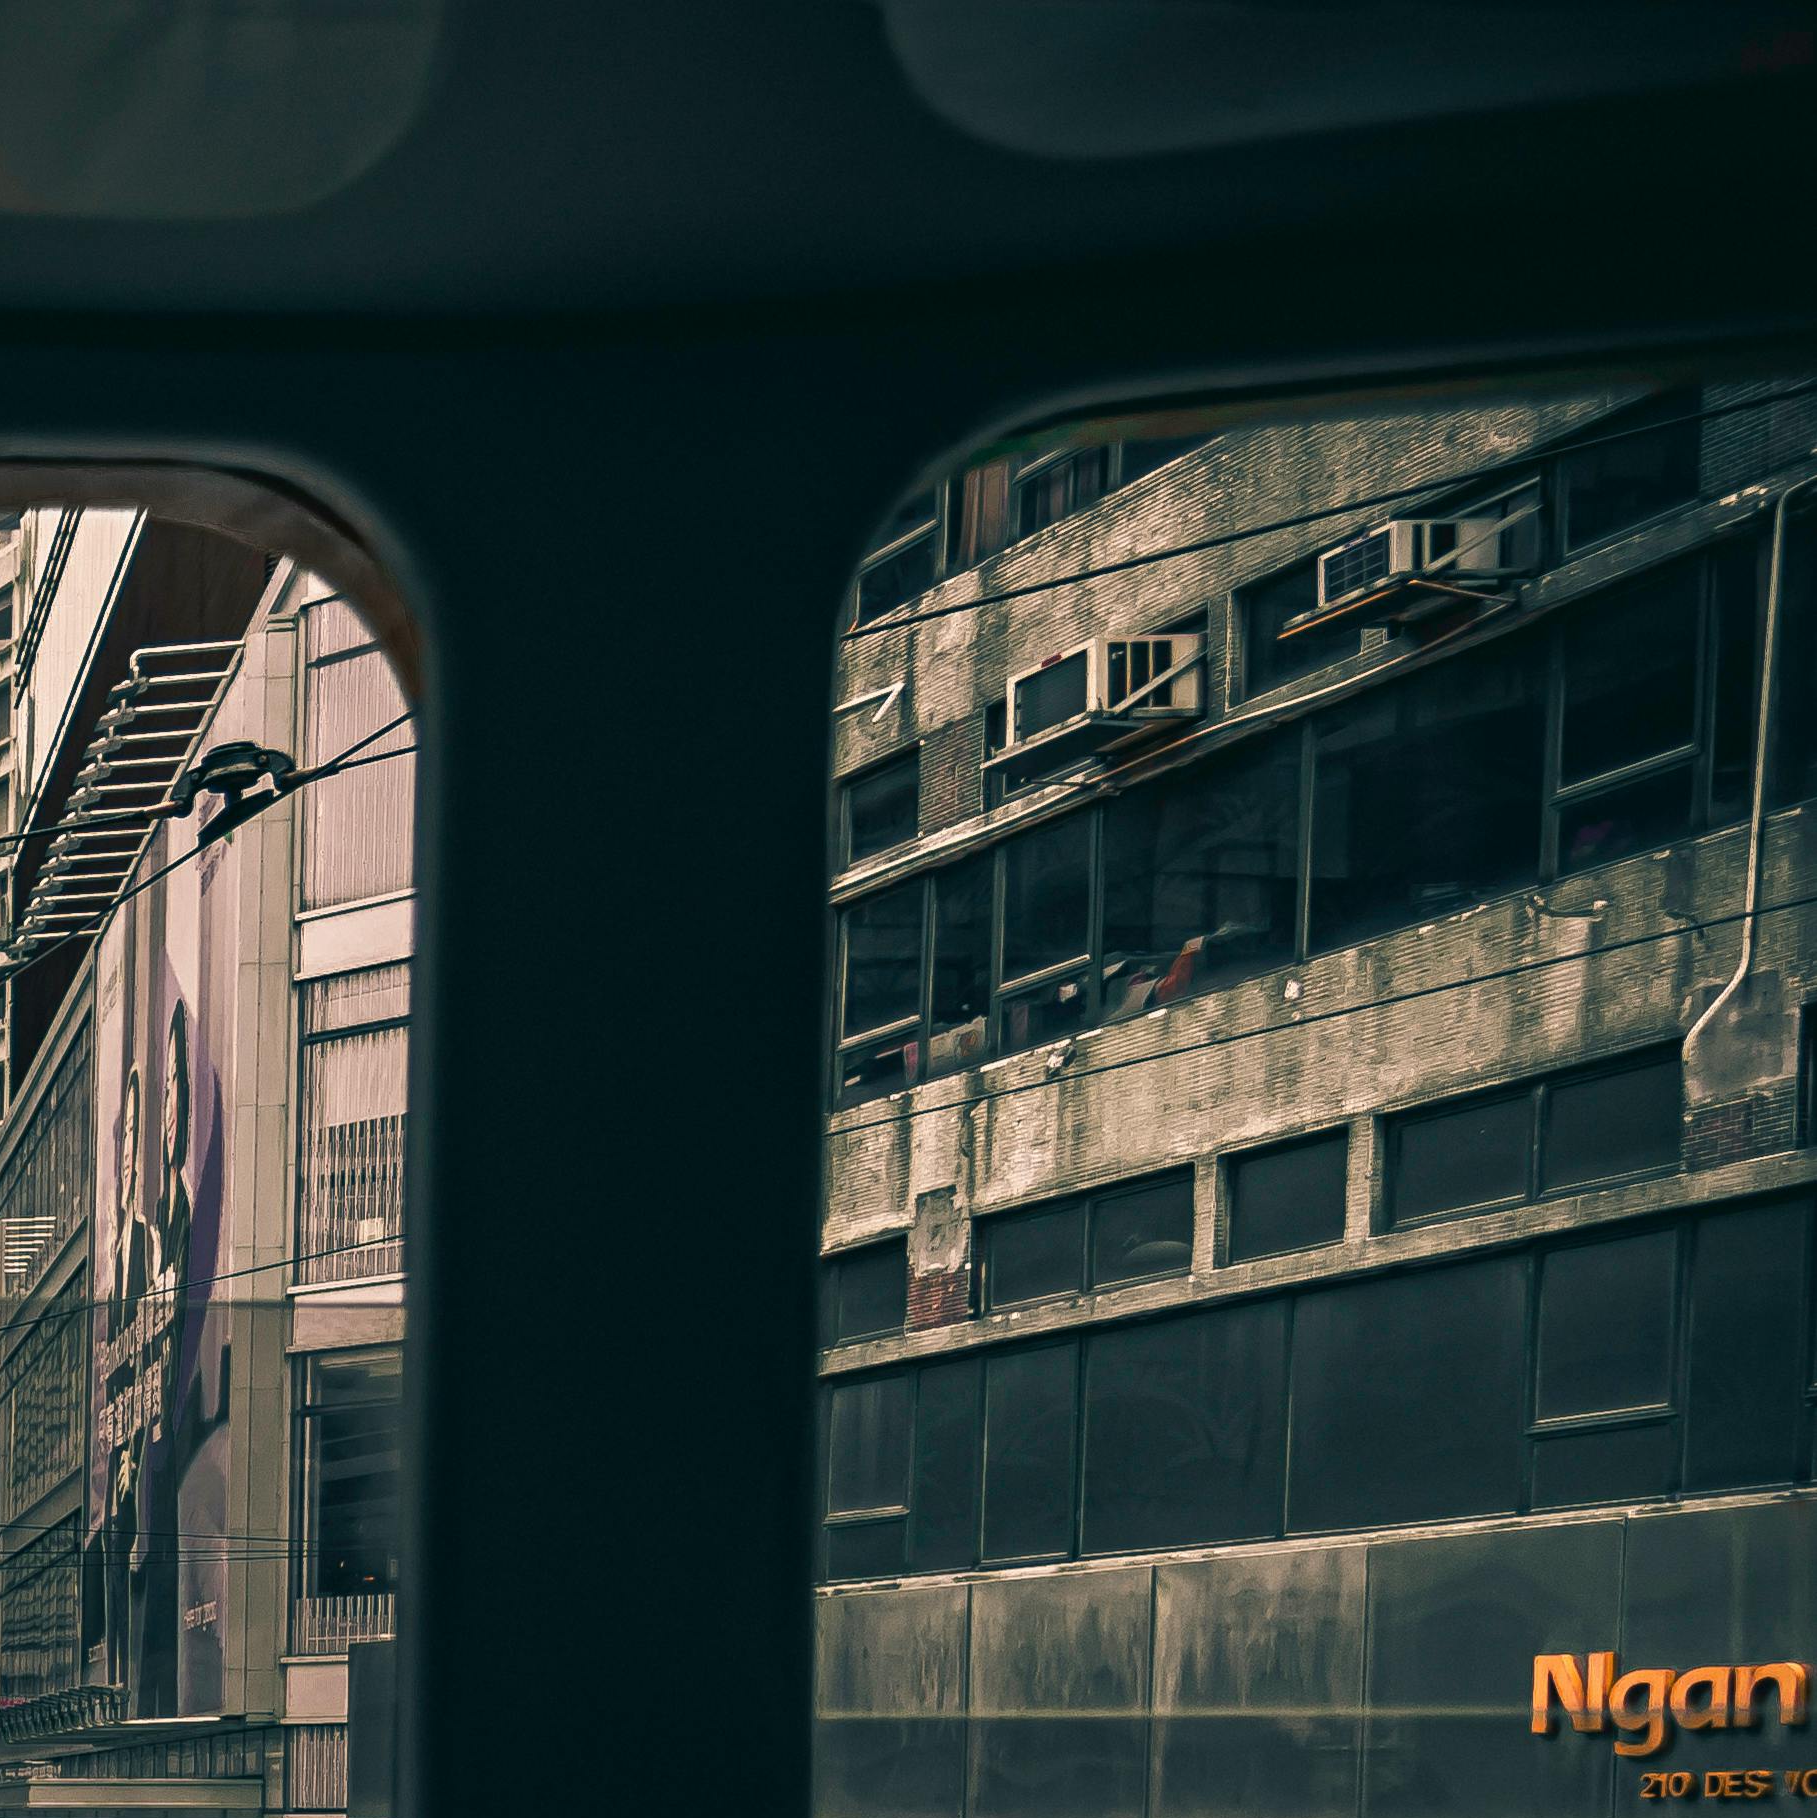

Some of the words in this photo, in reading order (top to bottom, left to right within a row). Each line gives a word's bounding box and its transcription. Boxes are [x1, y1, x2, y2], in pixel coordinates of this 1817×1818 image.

[1531, 1651, 1809, 1758] Ngan
[1640, 1772, 1693, 1799] 210
[1704, 1770, 1774, 1798] DES
